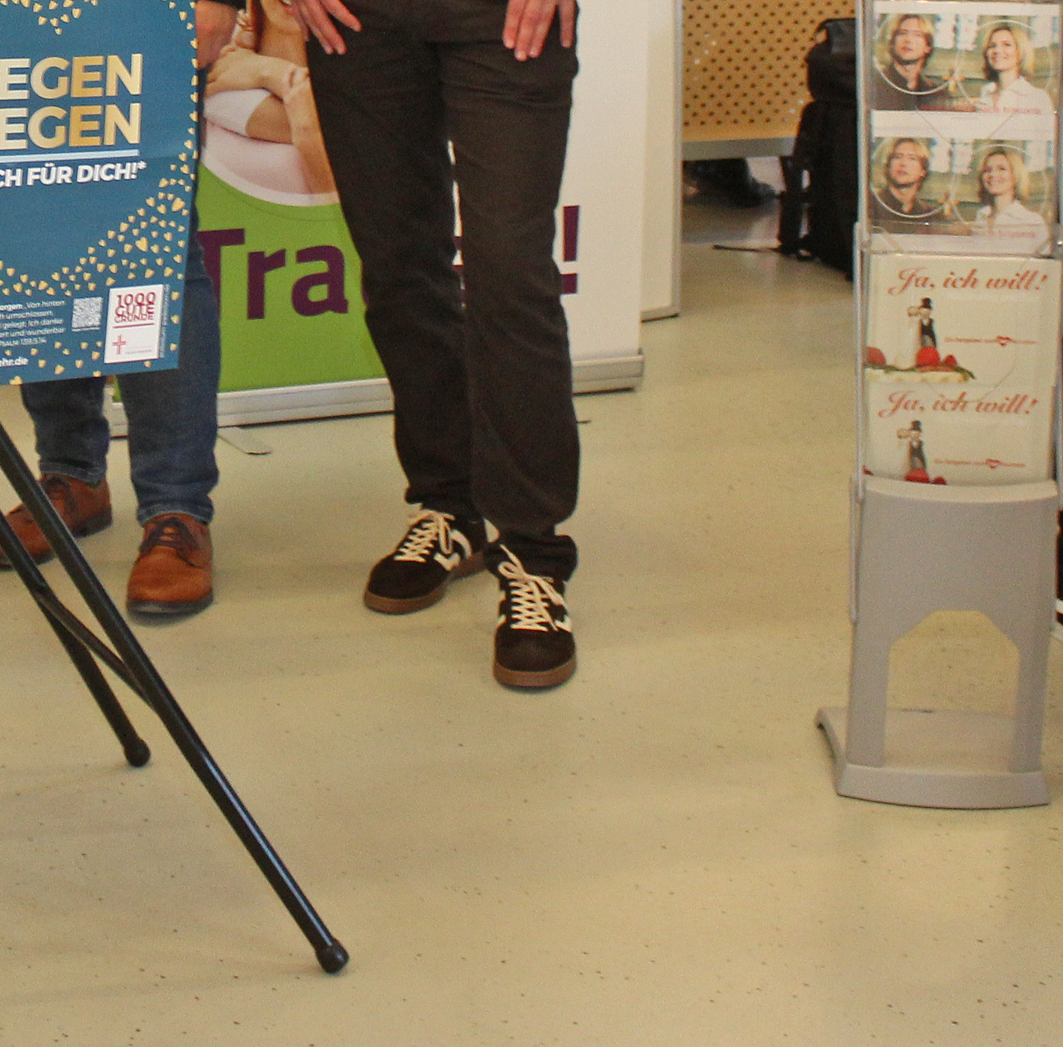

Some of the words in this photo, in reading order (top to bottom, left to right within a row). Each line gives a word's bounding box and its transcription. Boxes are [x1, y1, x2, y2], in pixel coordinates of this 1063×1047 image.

[26, 162, 74, 186] FÜR
[887, 266, 935, 295] Ja,
[942, 268, 978, 290] ich
[985, 269, 1048, 291] will!
[115, 304, 154, 316] GUTE
[116, 291, 156, 306] 1000
[877, 389, 926, 418] Ja,
[932, 391, 967, 412] ich
[974, 393, 1040, 415] will!
